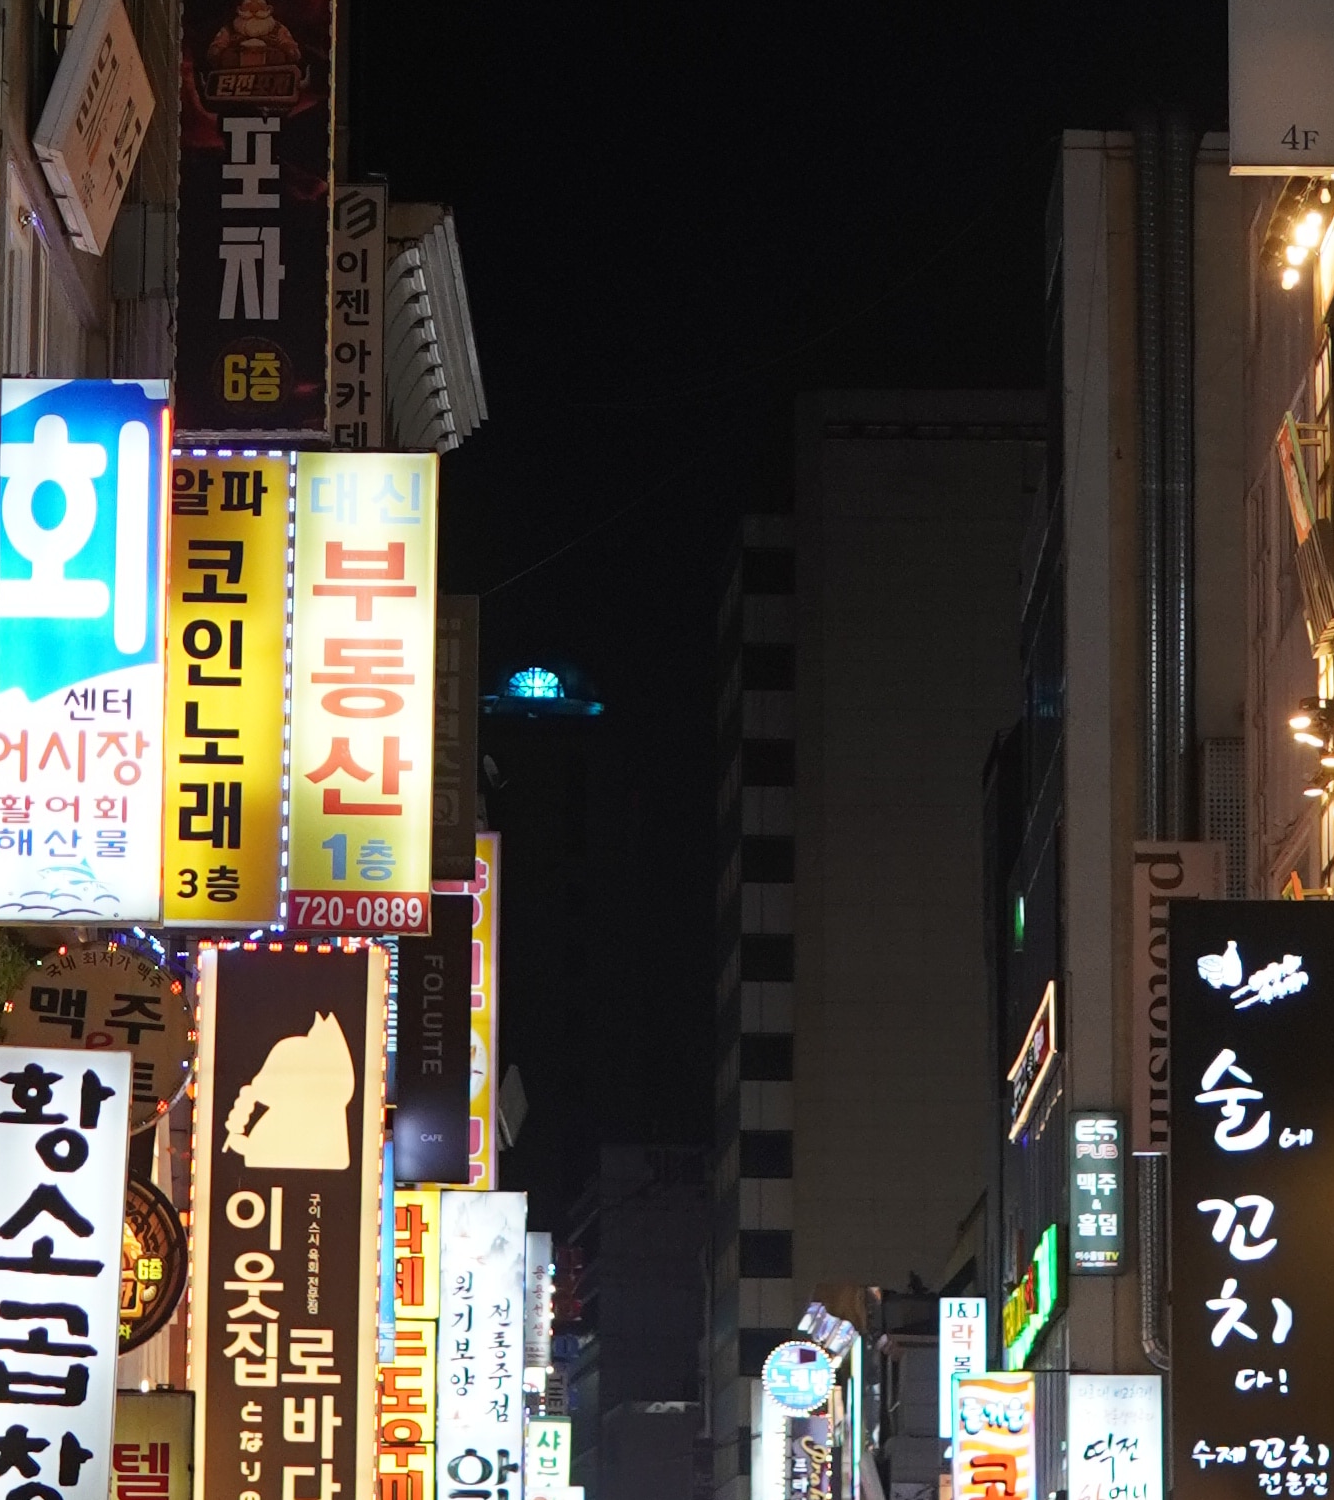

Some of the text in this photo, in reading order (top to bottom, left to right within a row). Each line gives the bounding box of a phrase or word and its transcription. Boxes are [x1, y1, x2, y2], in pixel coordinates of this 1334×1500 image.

[1279, 123, 1320, 152] 4F
[222, 351, 283, 404] 6층
[172, 469, 268, 517] 알파
[310, 471, 423, 526] 대신
[178, 539, 248, 851] 코인노래
[304, 541, 418, 817] 부동산
[63, 688, 133, 722] 센터
[322, 834, 397, 882] 1층
[178, 868, 241, 905] 3층
[295, 895, 424, 929] 720-0889
[30, 986, 165, 1045] 맥주
[420, 1133, 444, 1143] CAFE
[1075, 1143, 1119, 1160] PUB
[1076, 1173, 1117, 1196] 맥주
[308, 1193, 321, 1219] 구이
[1077, 1213, 1118, 1237] 홀덤
[307, 1222, 321, 1246] 스시
[137, 1258, 163, 1281] 6층
[223, 1187, 285, 1388] 이웃집
[450, 1271, 476, 1396] 원기보양
[485, 1298, 513, 1423] 전통주점
[1083, 1432, 1140, 1484] 역전
